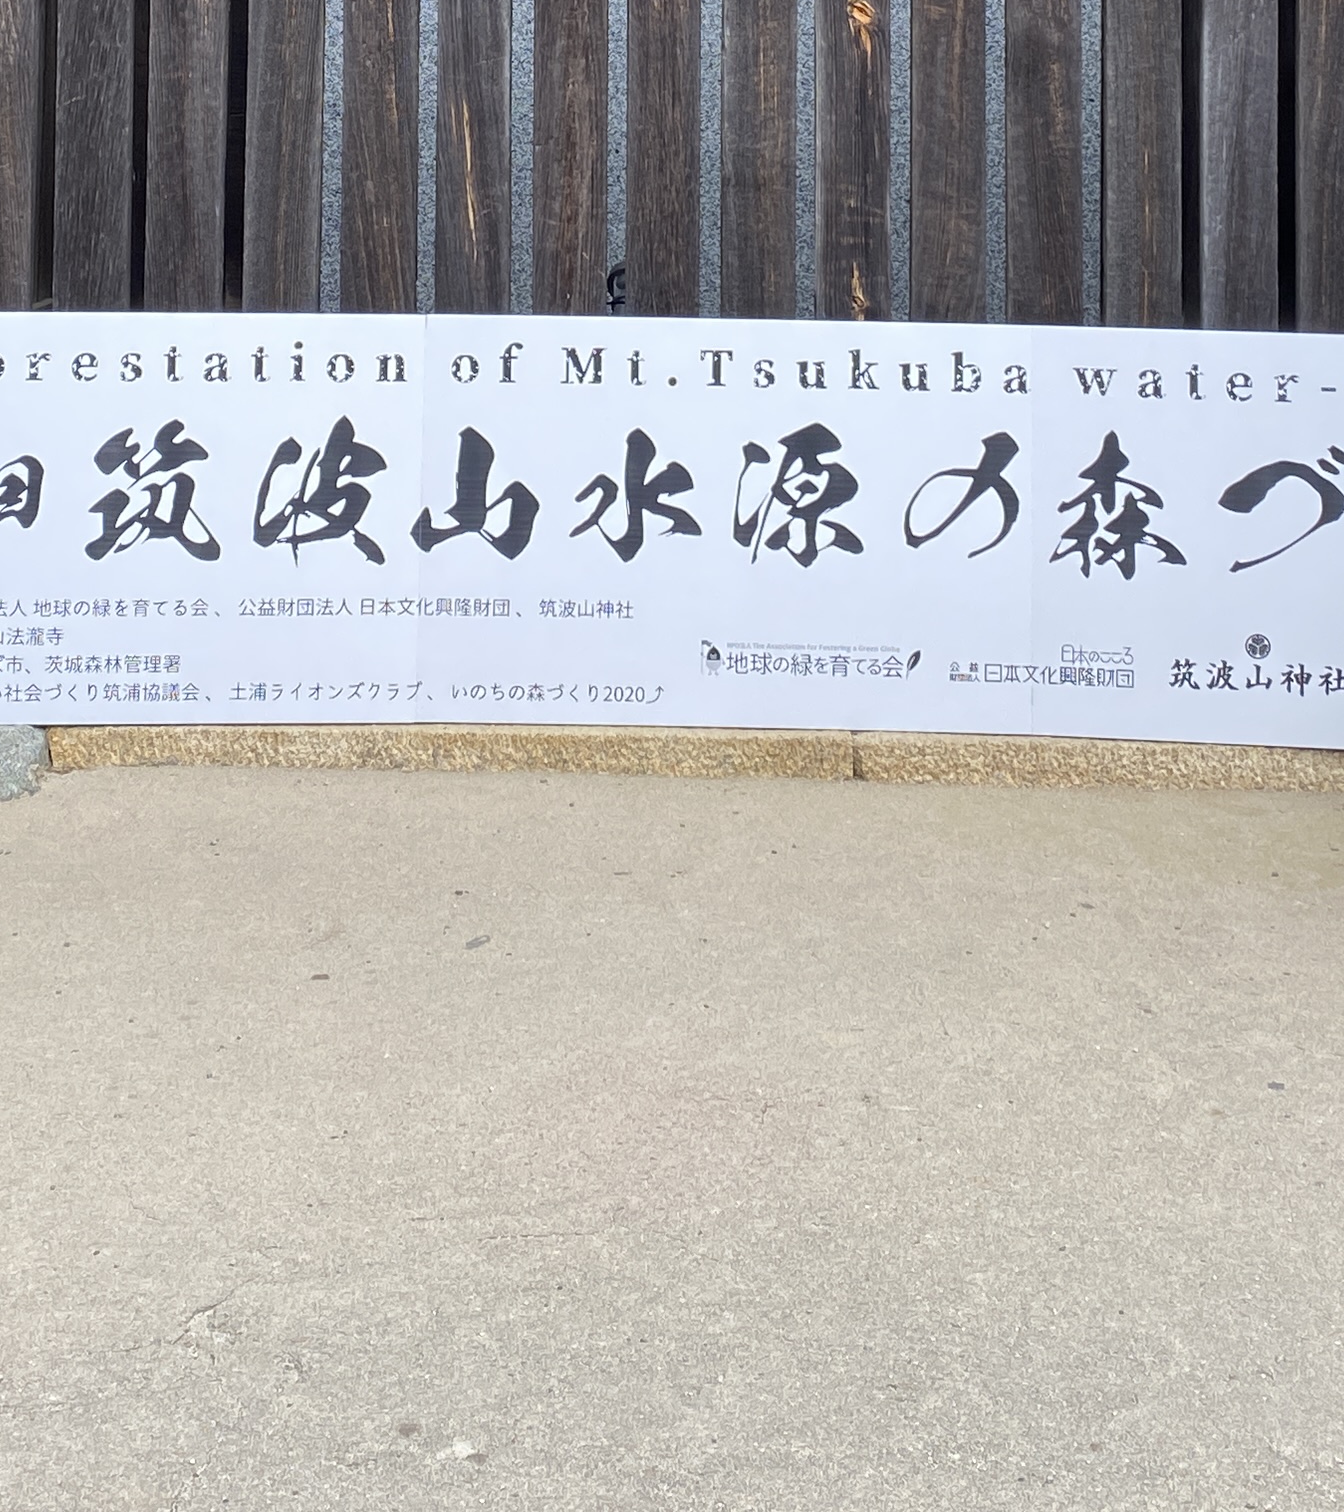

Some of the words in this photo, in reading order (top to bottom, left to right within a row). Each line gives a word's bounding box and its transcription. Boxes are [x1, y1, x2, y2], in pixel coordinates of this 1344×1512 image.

[451, 342, 519, 387] of
[561, 346, 1032, 396] Mt.Tsukuba
[538, 599, 635, 620] 筑波山神社
[725, 651, 904, 679] 地球の緑を育てる会
[1061, 644, 1134, 667] 日本のこころ
[984, 662, 1135, 689] 日本文化興隆財団
